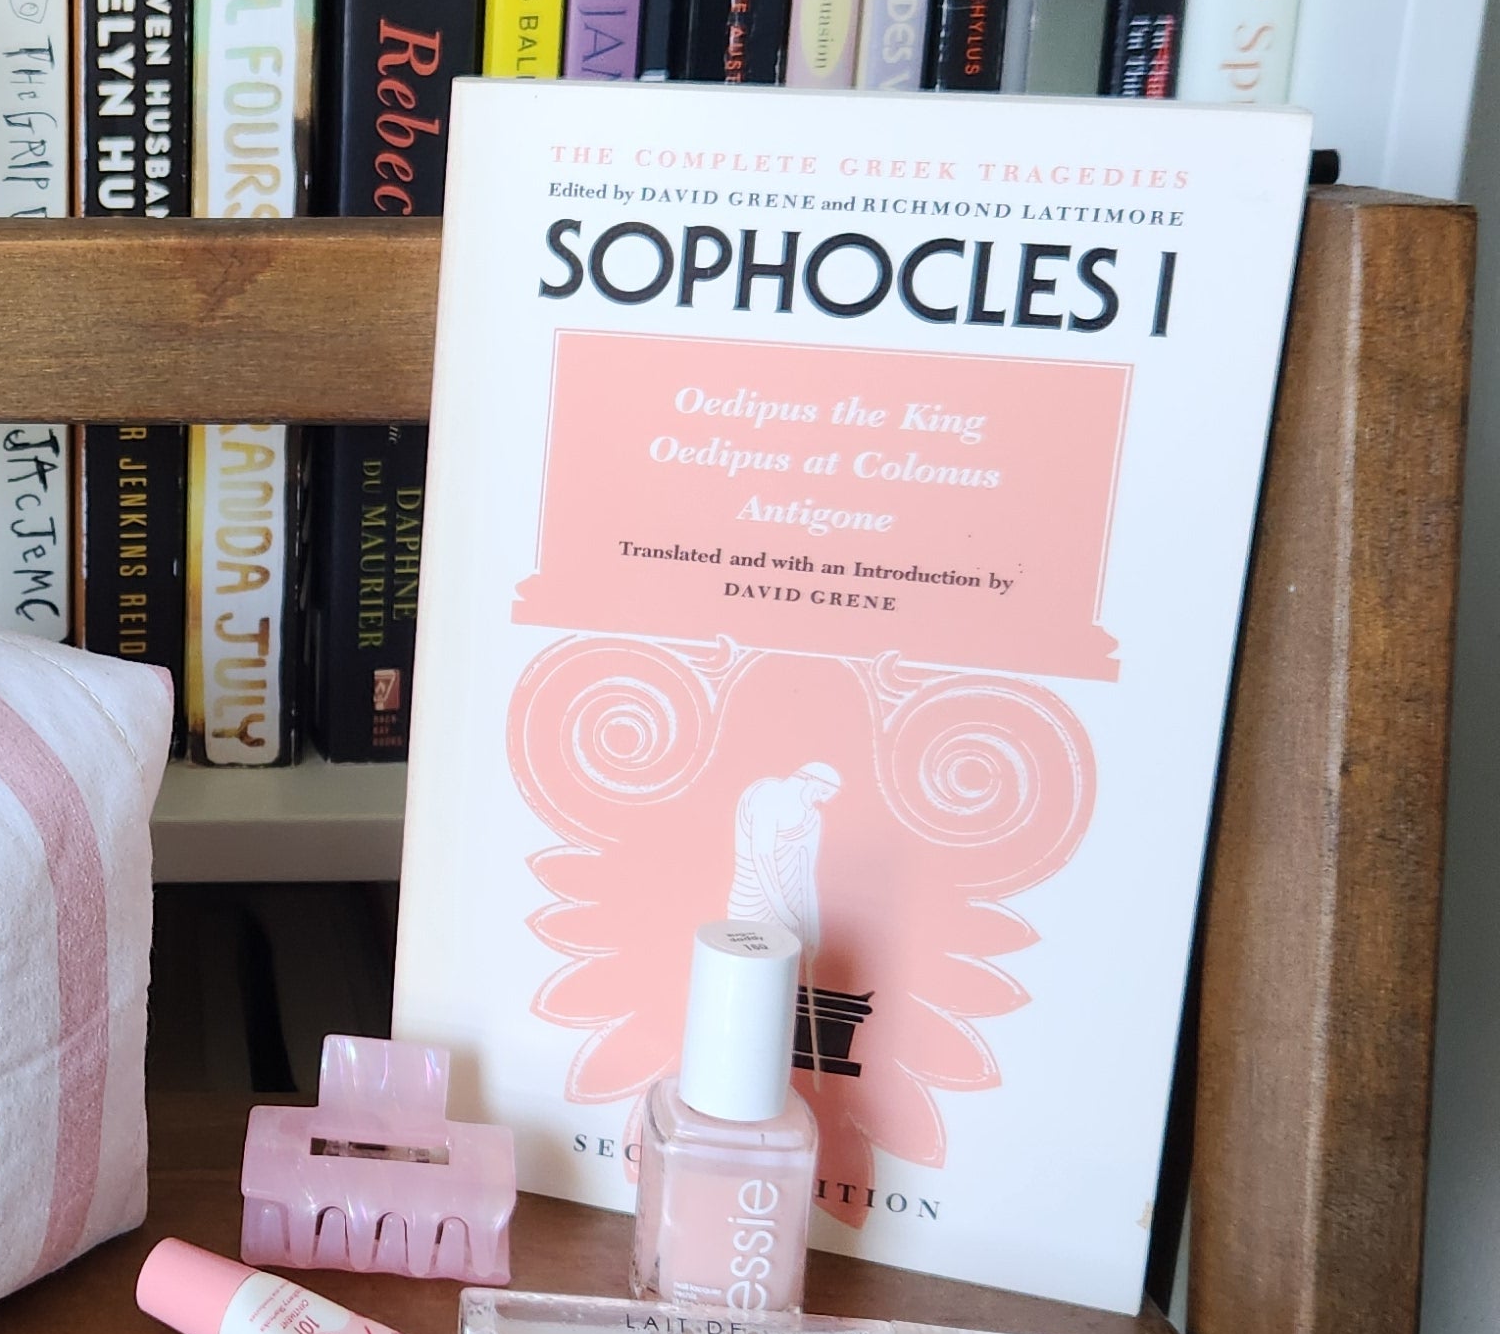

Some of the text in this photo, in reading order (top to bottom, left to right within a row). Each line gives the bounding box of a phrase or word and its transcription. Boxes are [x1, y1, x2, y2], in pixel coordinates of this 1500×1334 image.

[550, 145, 1192, 191] THE COMPLETE GREEK TRAGEDIES
[547, 181, 1185, 228] Edited by DAVID GRENE and RICHMOND LATTIMORE
[537, 216, 1178, 338] SOPHOCLES I
[673, 386, 987, 445] Oedipus the King
[648, 435, 1002, 491] Oedipus at Colonus
[736, 495, 895, 538] Antigone
[118, 457, 148, 656] JENKINS REID
[357, 460, 386, 651] DU MAURIER
[393, 485, 424, 622] DAPHNE
[618, 539, 1015, 595] Translated and with an Introduction by
[723, 582, 898, 612] DAVID GRENE
[211, 611, 271, 748] JULY
[726, 1177, 780, 1323] essie
[625, 1313, 688, 1334] LAIT
